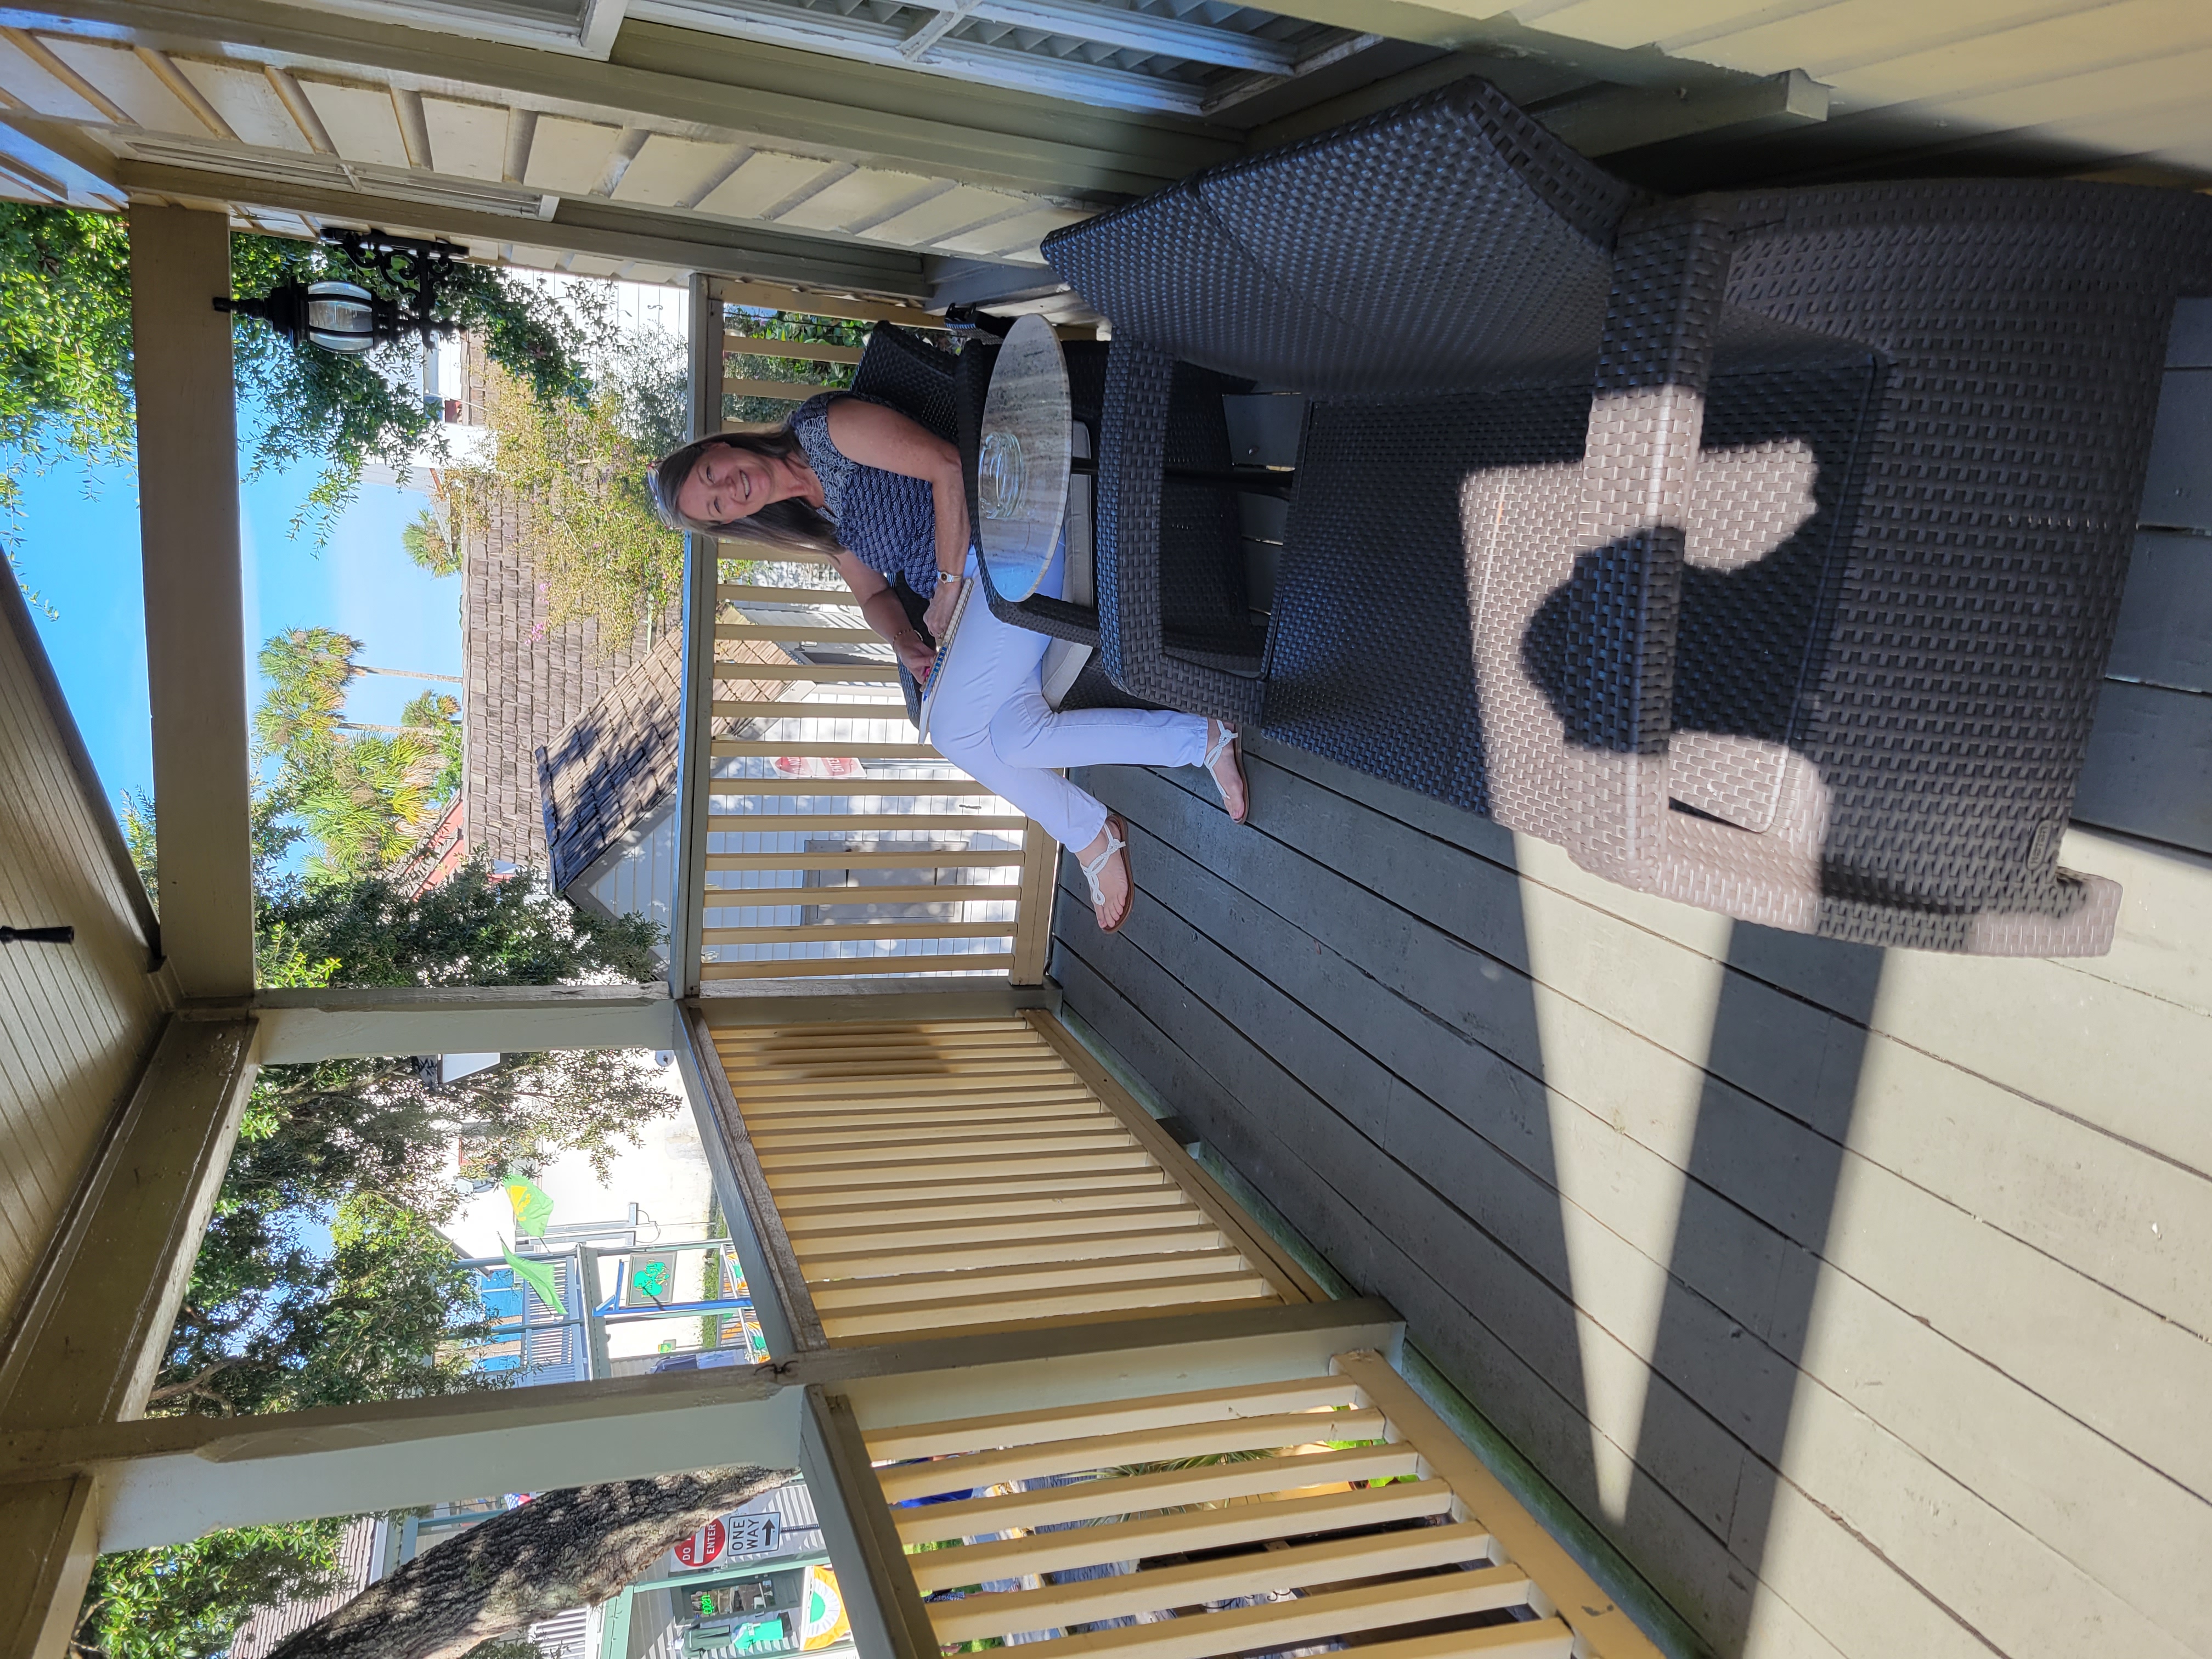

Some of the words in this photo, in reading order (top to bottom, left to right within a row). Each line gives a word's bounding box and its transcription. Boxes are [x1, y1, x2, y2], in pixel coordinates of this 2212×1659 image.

[707, 1524, 716, 1554] ENTER
[732, 1520, 745, 1551] ONE
[746, 1519, 759, 1550] WAY
[682, 1547, 691, 1561] DO
